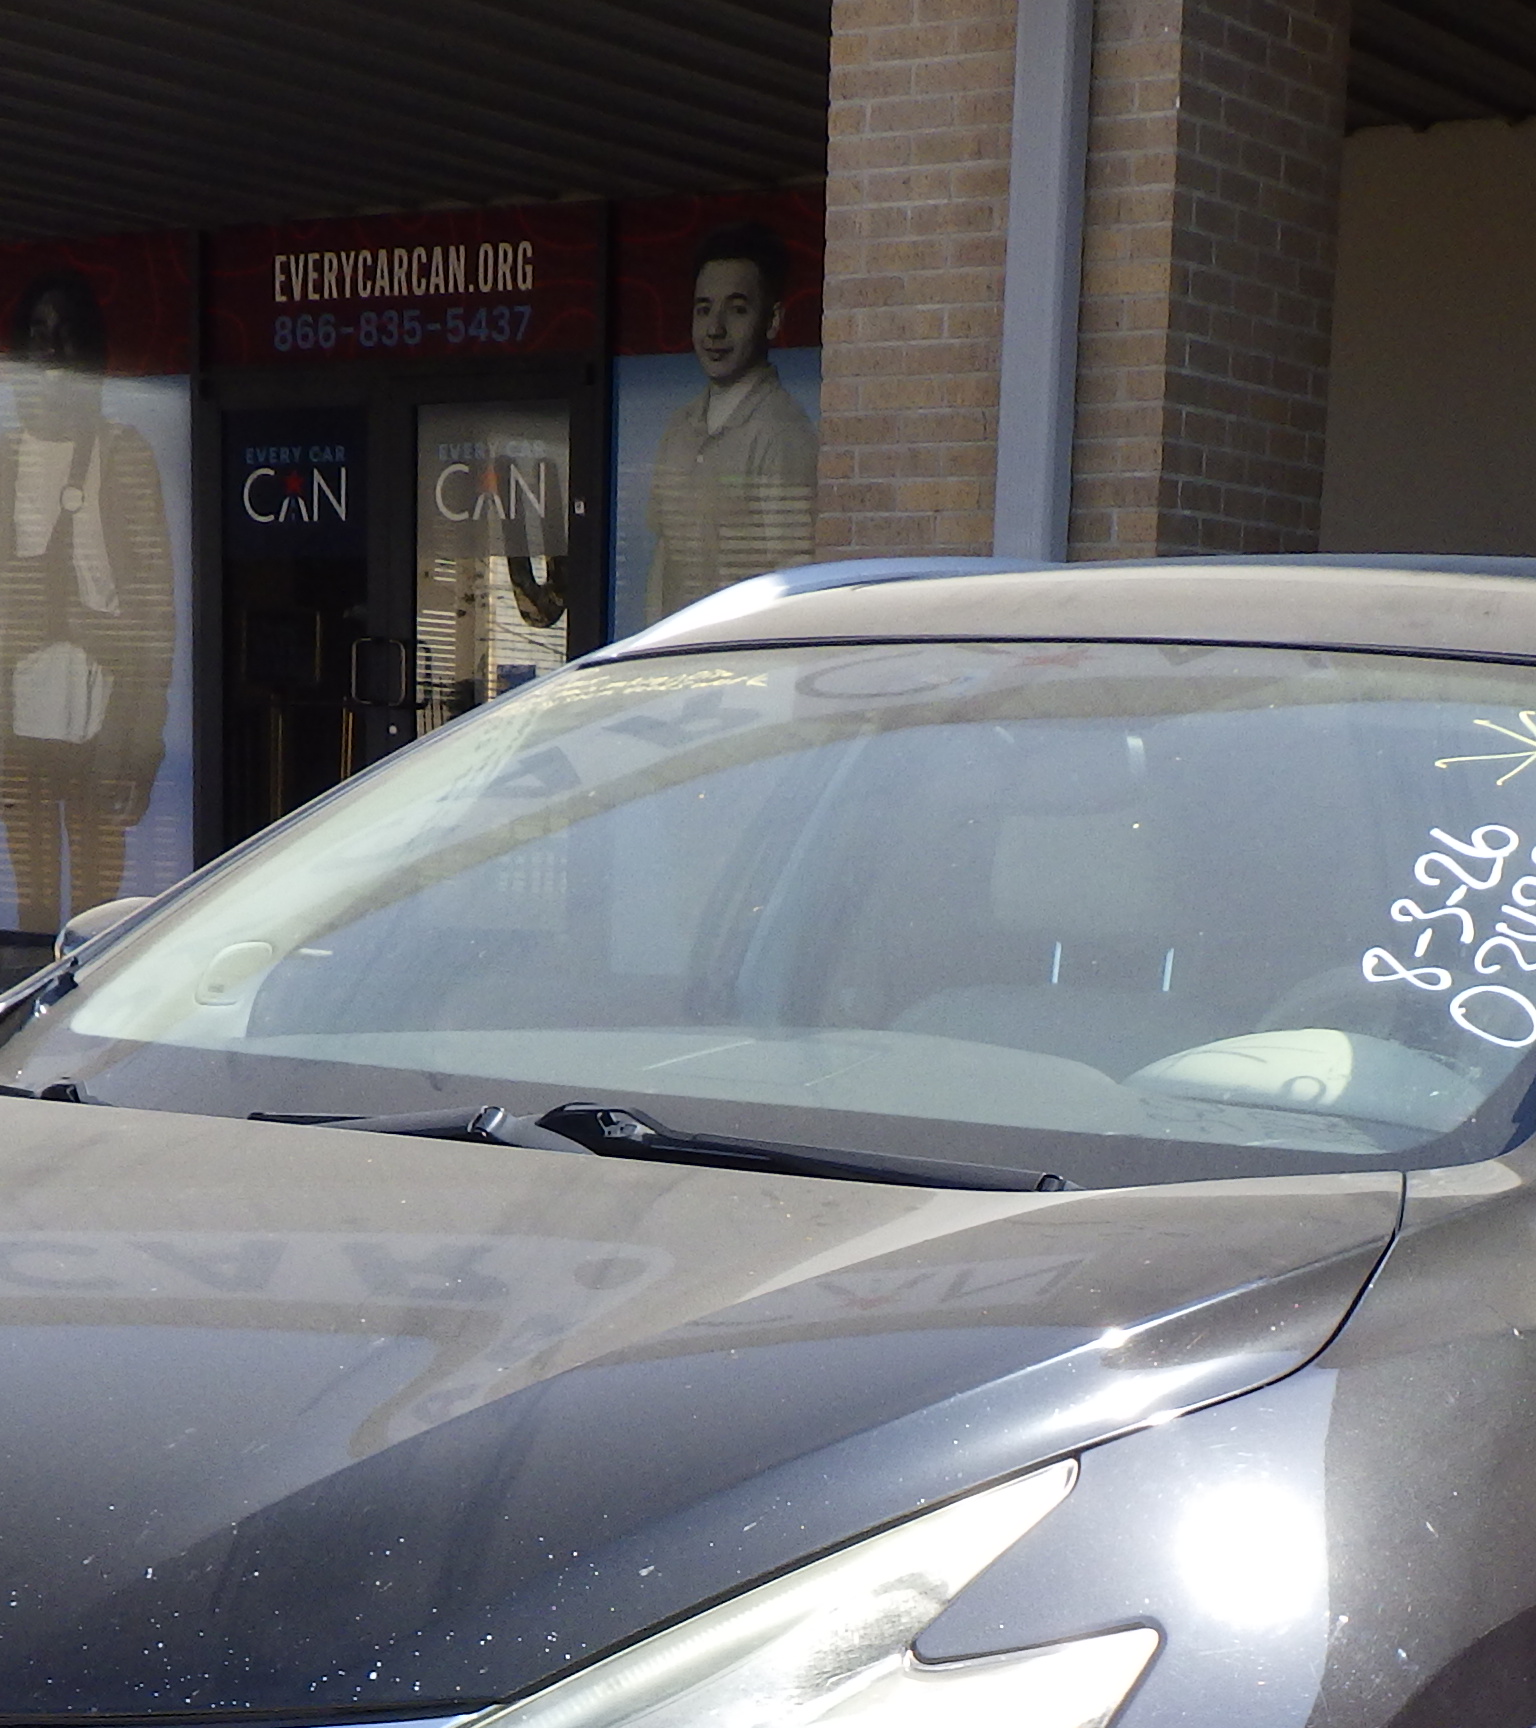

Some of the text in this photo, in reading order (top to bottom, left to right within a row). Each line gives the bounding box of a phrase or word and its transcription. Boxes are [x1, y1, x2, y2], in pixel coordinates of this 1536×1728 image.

[274, 240, 534, 303] EVERYCARCAN.ORG
[274, 304, 533, 352] 866-835-5437
[245, 444, 346, 464] EVERY CAR
[438, 440, 498, 461] EVERY
[243, 466, 347, 523] CAN
[435, 462, 546, 521] CAN
[1362, 824, 1520, 991] 8-3-26
